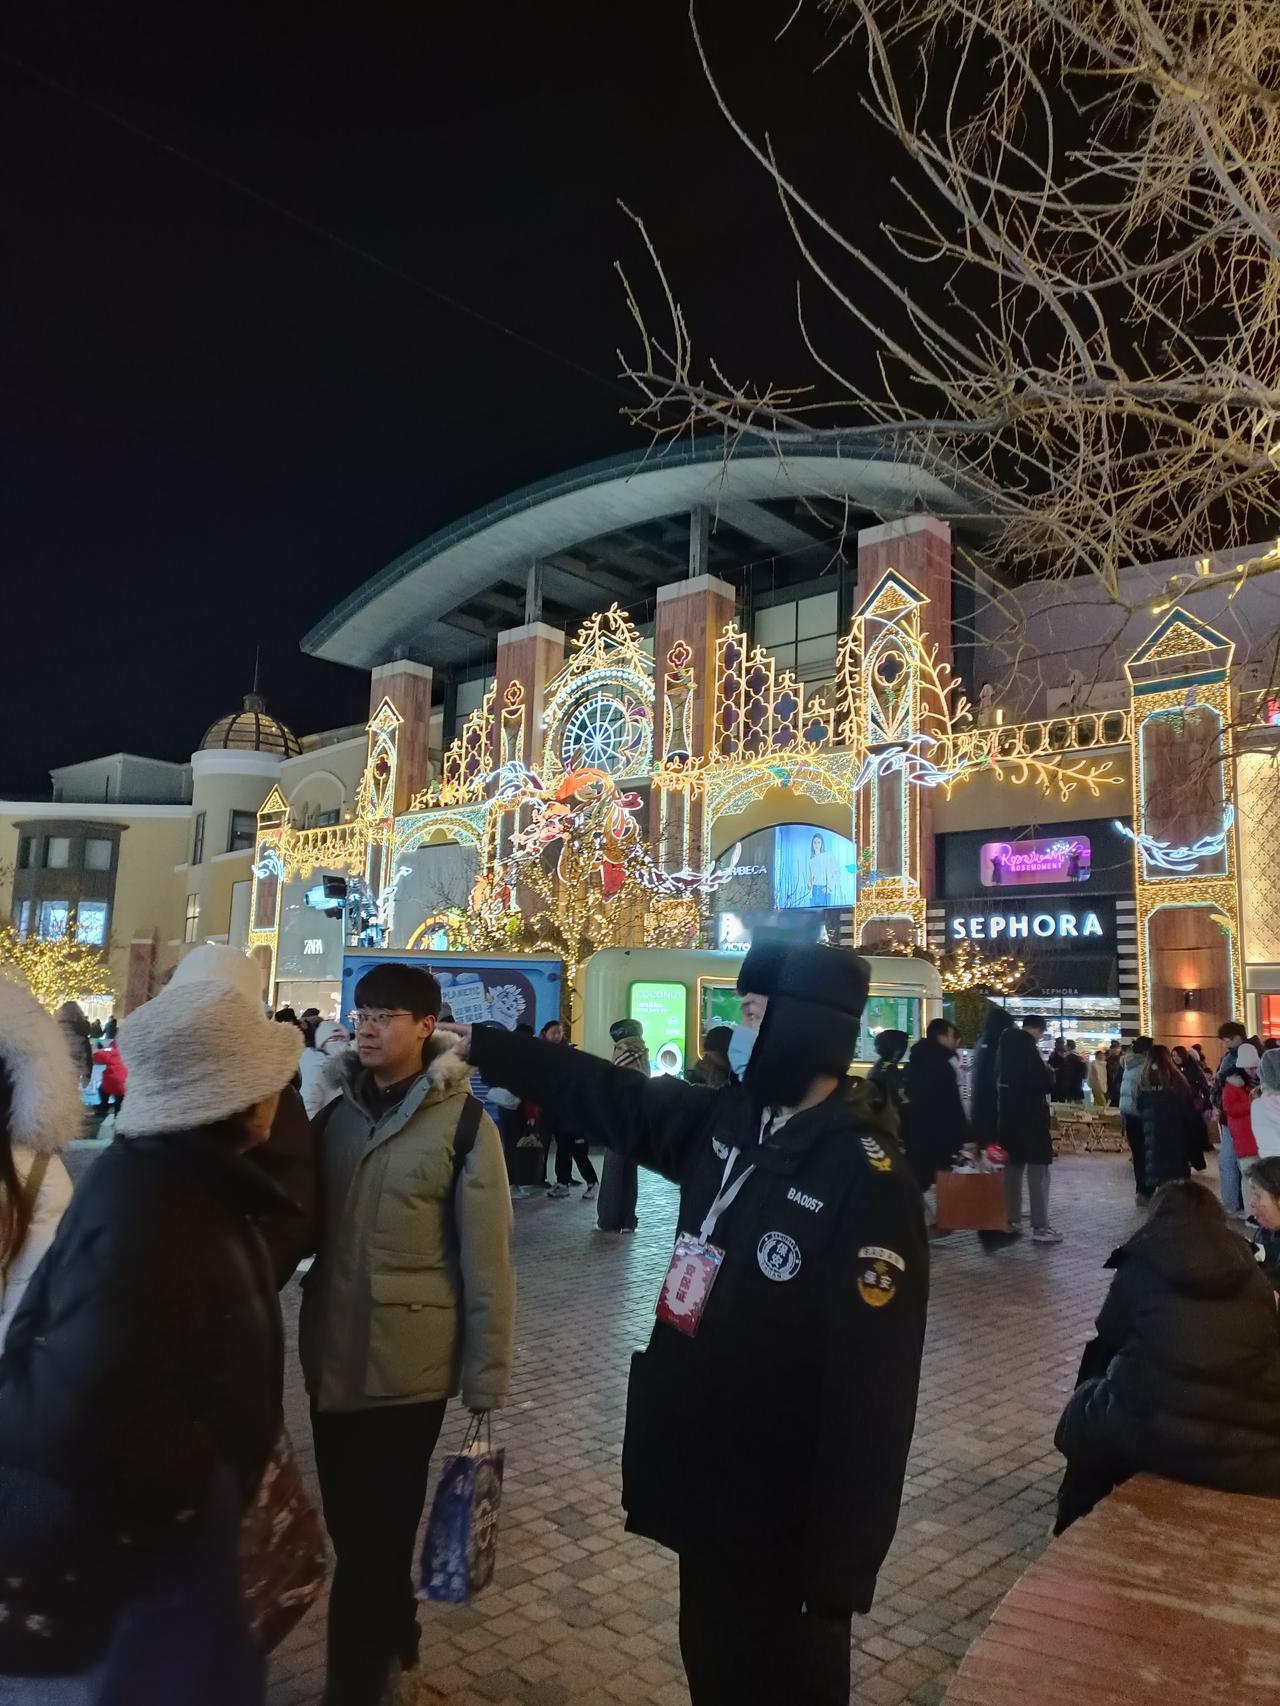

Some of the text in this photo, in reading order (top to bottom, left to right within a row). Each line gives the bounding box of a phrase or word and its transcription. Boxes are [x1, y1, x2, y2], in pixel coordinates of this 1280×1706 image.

[953, 914, 1103, 939] SEPHORA
[304, 939, 323, 955] ZARA
[771, 1242, 788, 1268] 保安
